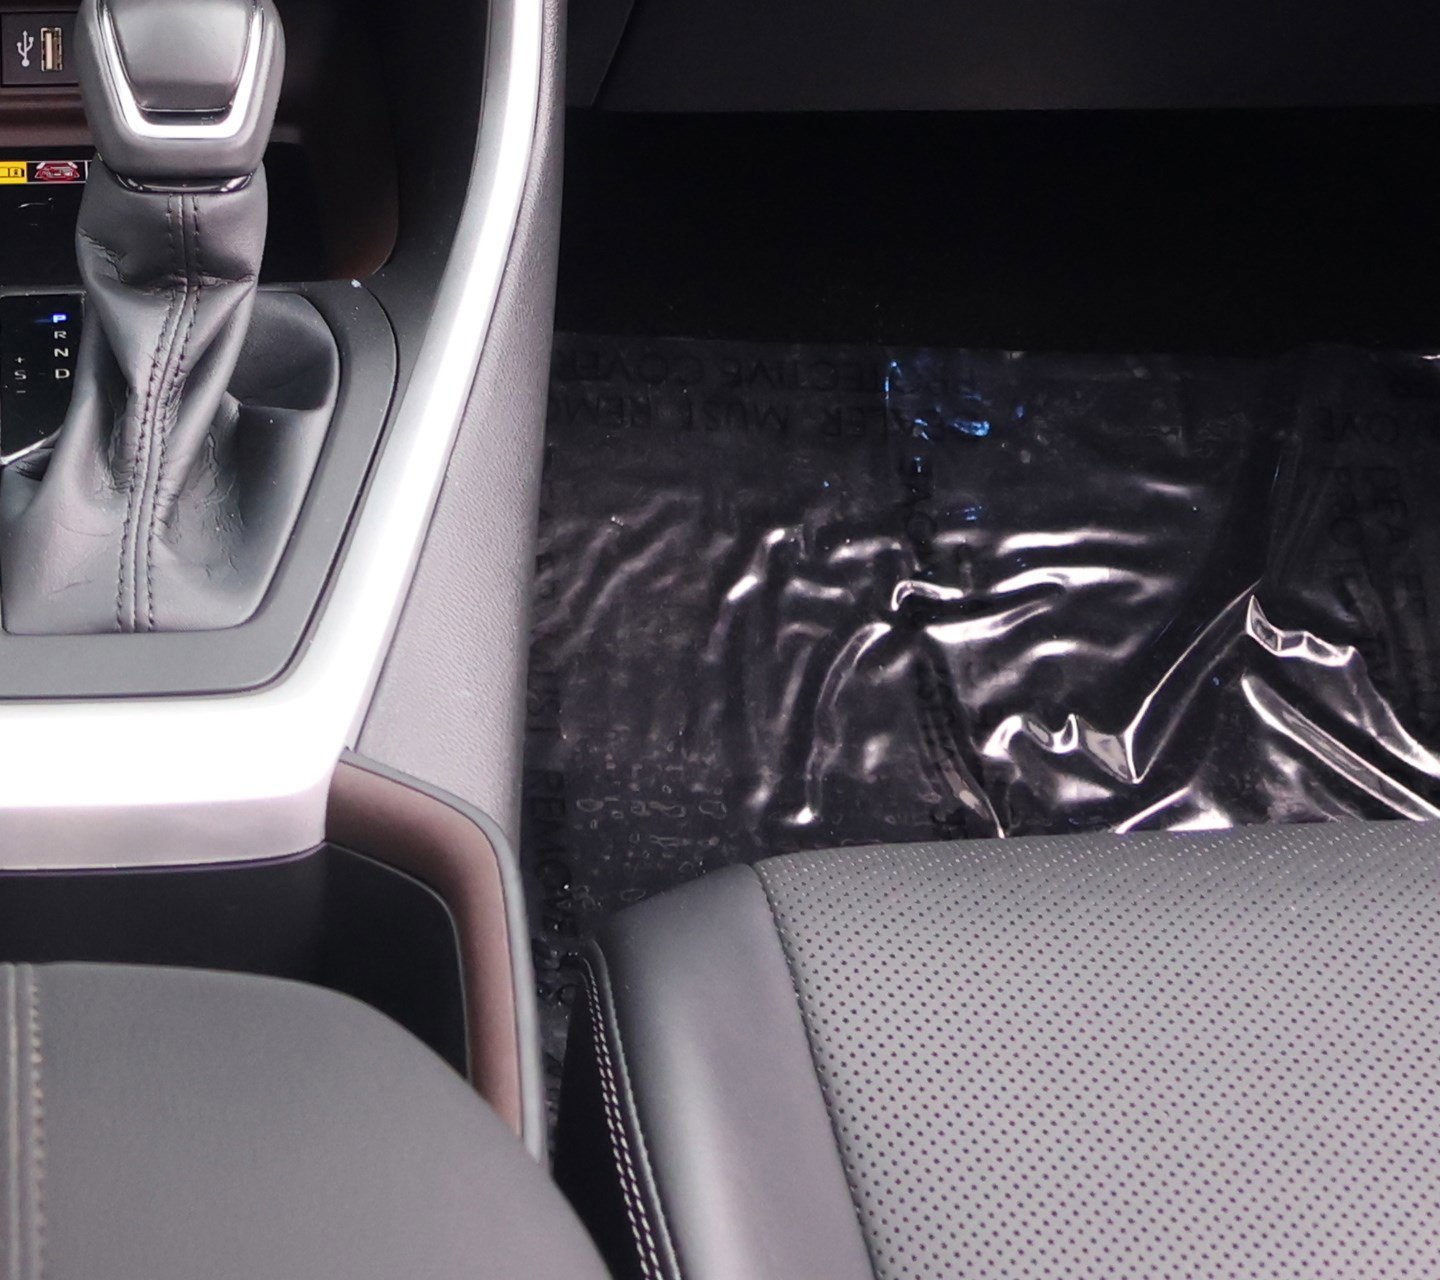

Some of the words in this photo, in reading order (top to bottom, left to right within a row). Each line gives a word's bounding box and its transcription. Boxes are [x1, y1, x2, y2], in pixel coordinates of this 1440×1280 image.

[52, 314, 67, 324] P
[54, 330, 67, 339] R
[54, 348, 69, 358] N
[14, 369, 28, 380] S
[54, 368, 71, 380] D
